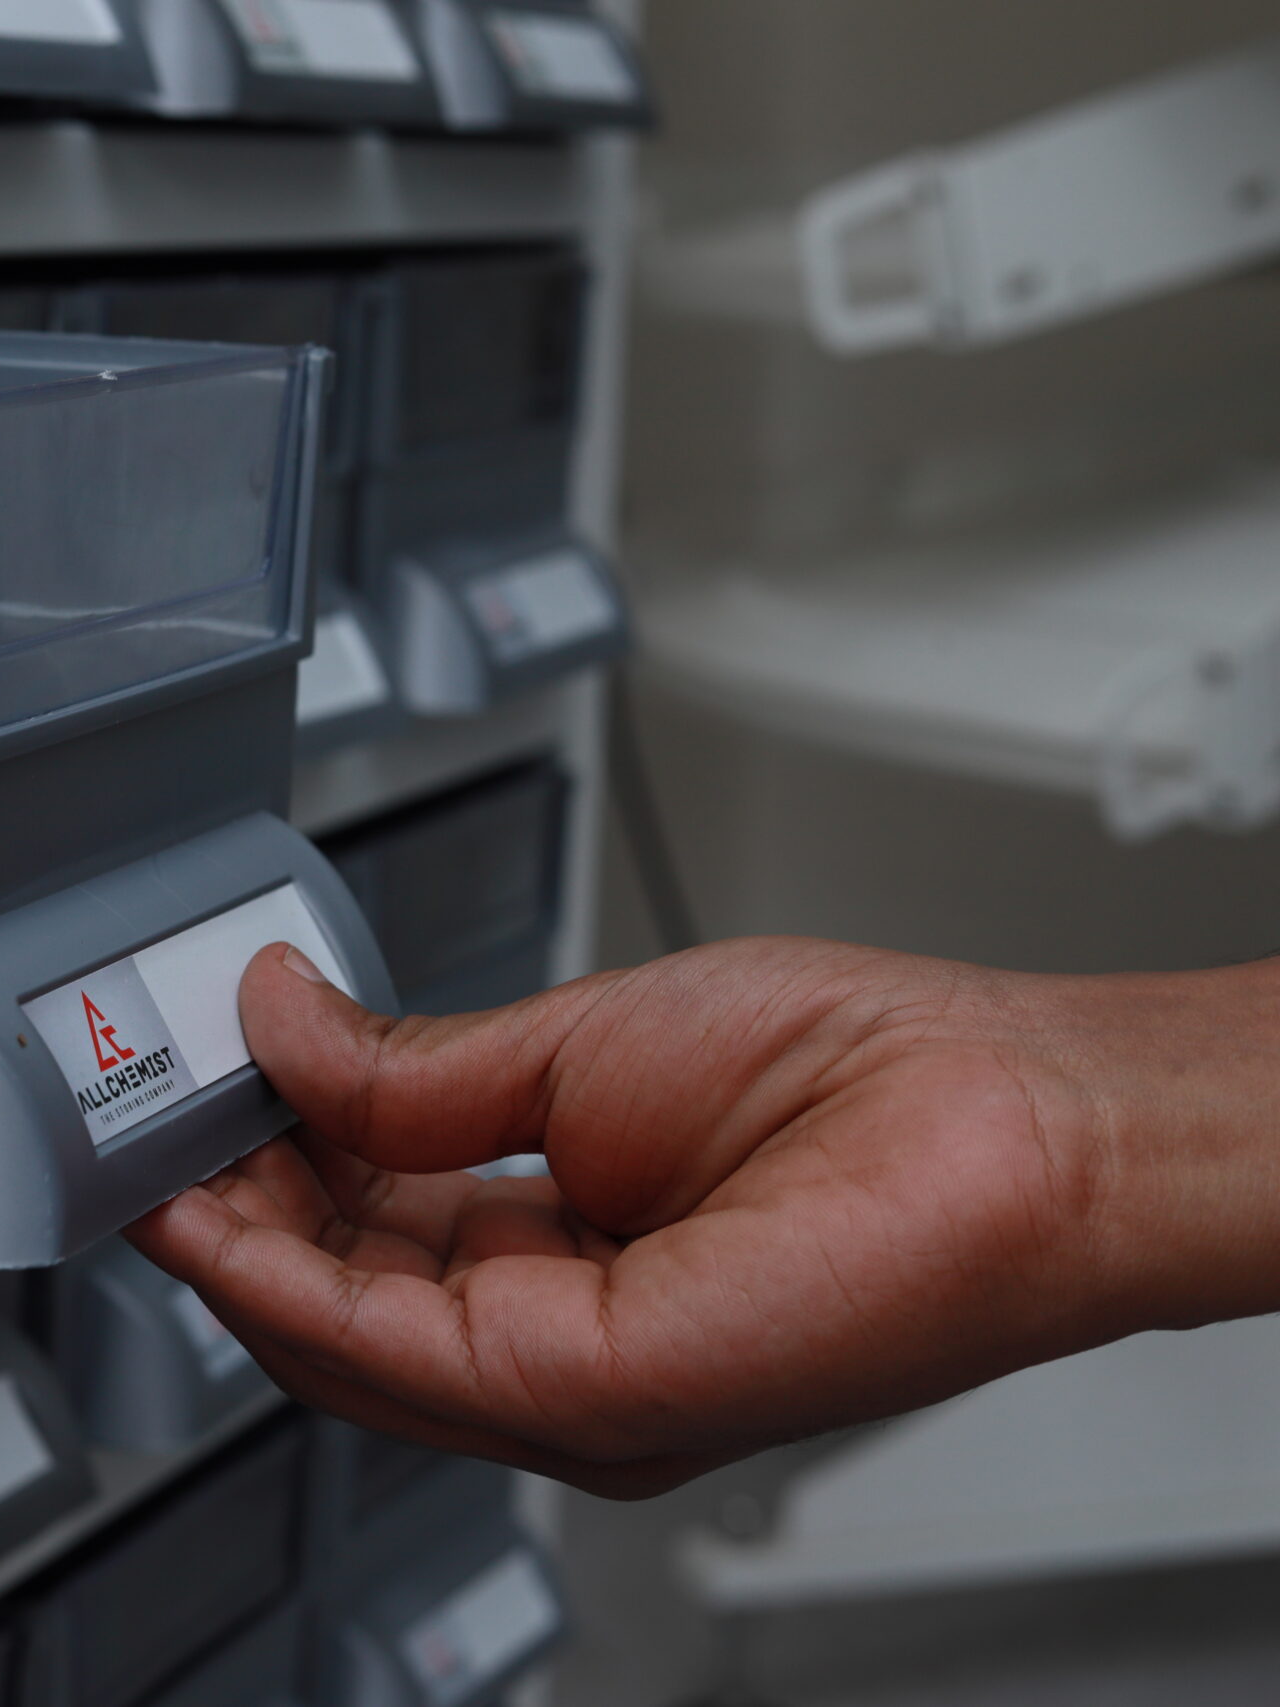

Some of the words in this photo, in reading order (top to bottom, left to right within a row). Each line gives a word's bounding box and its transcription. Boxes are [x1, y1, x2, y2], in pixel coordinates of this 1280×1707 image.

[77, 1046, 175, 1115] ALLCHEMIST
[100, 1111, 116, 1126] THE
[145, 1079, 176, 1102] COMPANY
